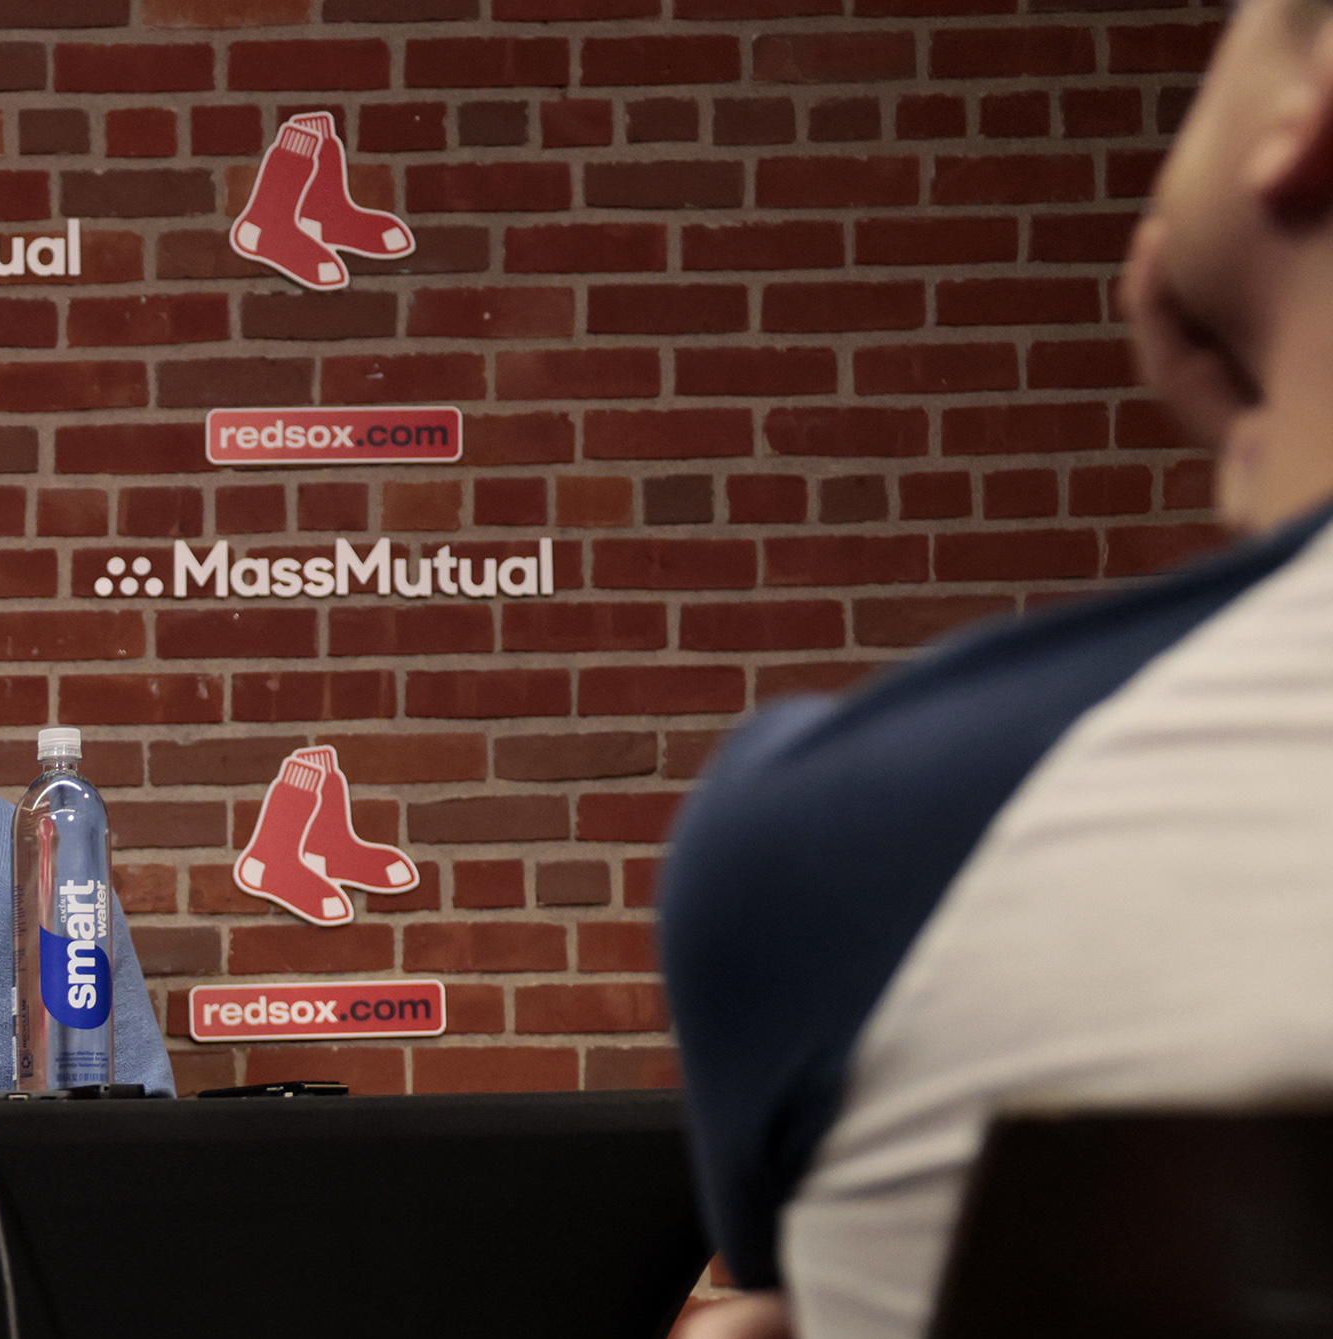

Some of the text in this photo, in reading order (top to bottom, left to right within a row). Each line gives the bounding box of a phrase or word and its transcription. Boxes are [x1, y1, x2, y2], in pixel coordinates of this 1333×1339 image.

[218, 420, 450, 449] redsox.com
[174, 537, 553, 598] MassMutual
[95, 880, 107, 939] water
[59, 879, 97, 1010] smart
[202, 995, 432, 1028] redsox.com
